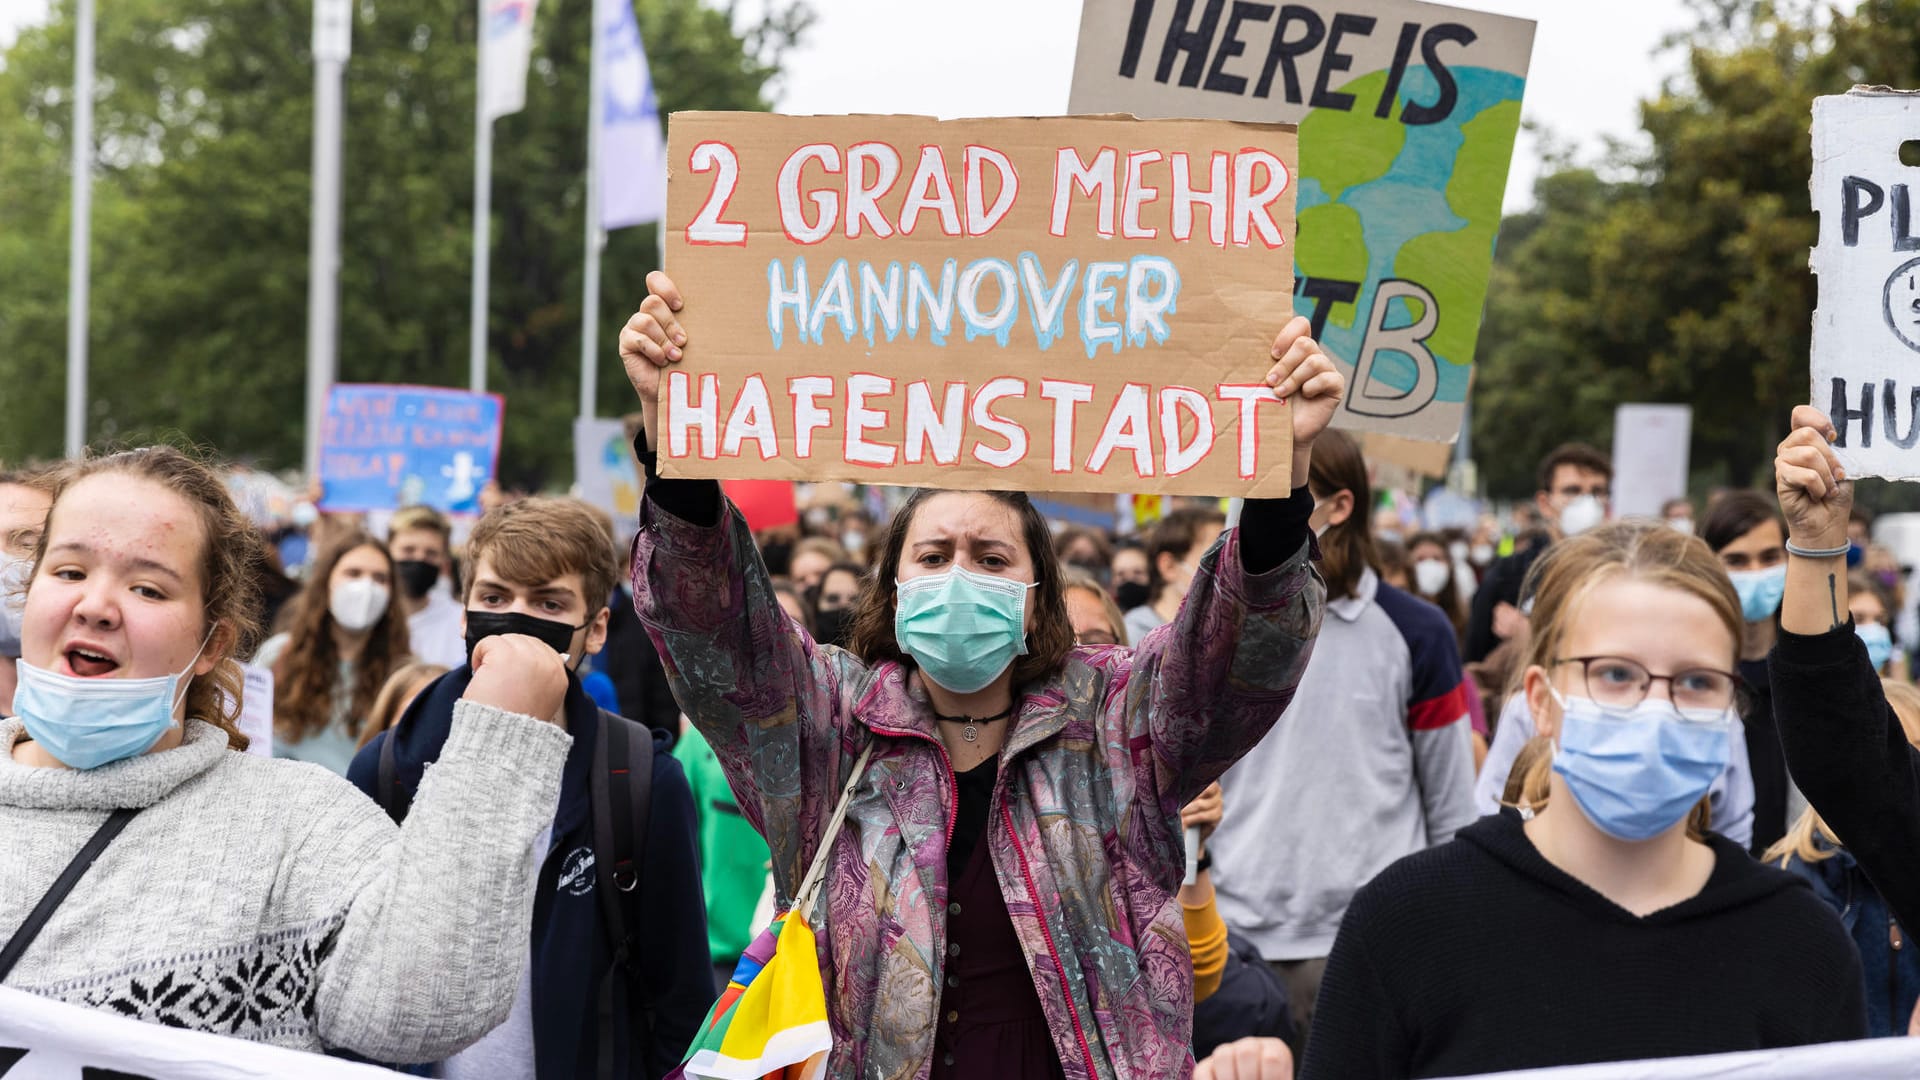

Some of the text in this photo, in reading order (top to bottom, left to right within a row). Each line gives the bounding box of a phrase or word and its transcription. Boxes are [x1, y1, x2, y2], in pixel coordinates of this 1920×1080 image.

[1118, 0, 1479, 126] THERE IS
[685, 139, 1290, 250] 2 GRAD MEHR
[766, 251, 1182, 359] HANNOVER
[1345, 277, 1441, 419] B
[666, 371, 1287, 480] HAFENSTADT
[1830, 376, 1920, 450] HU
